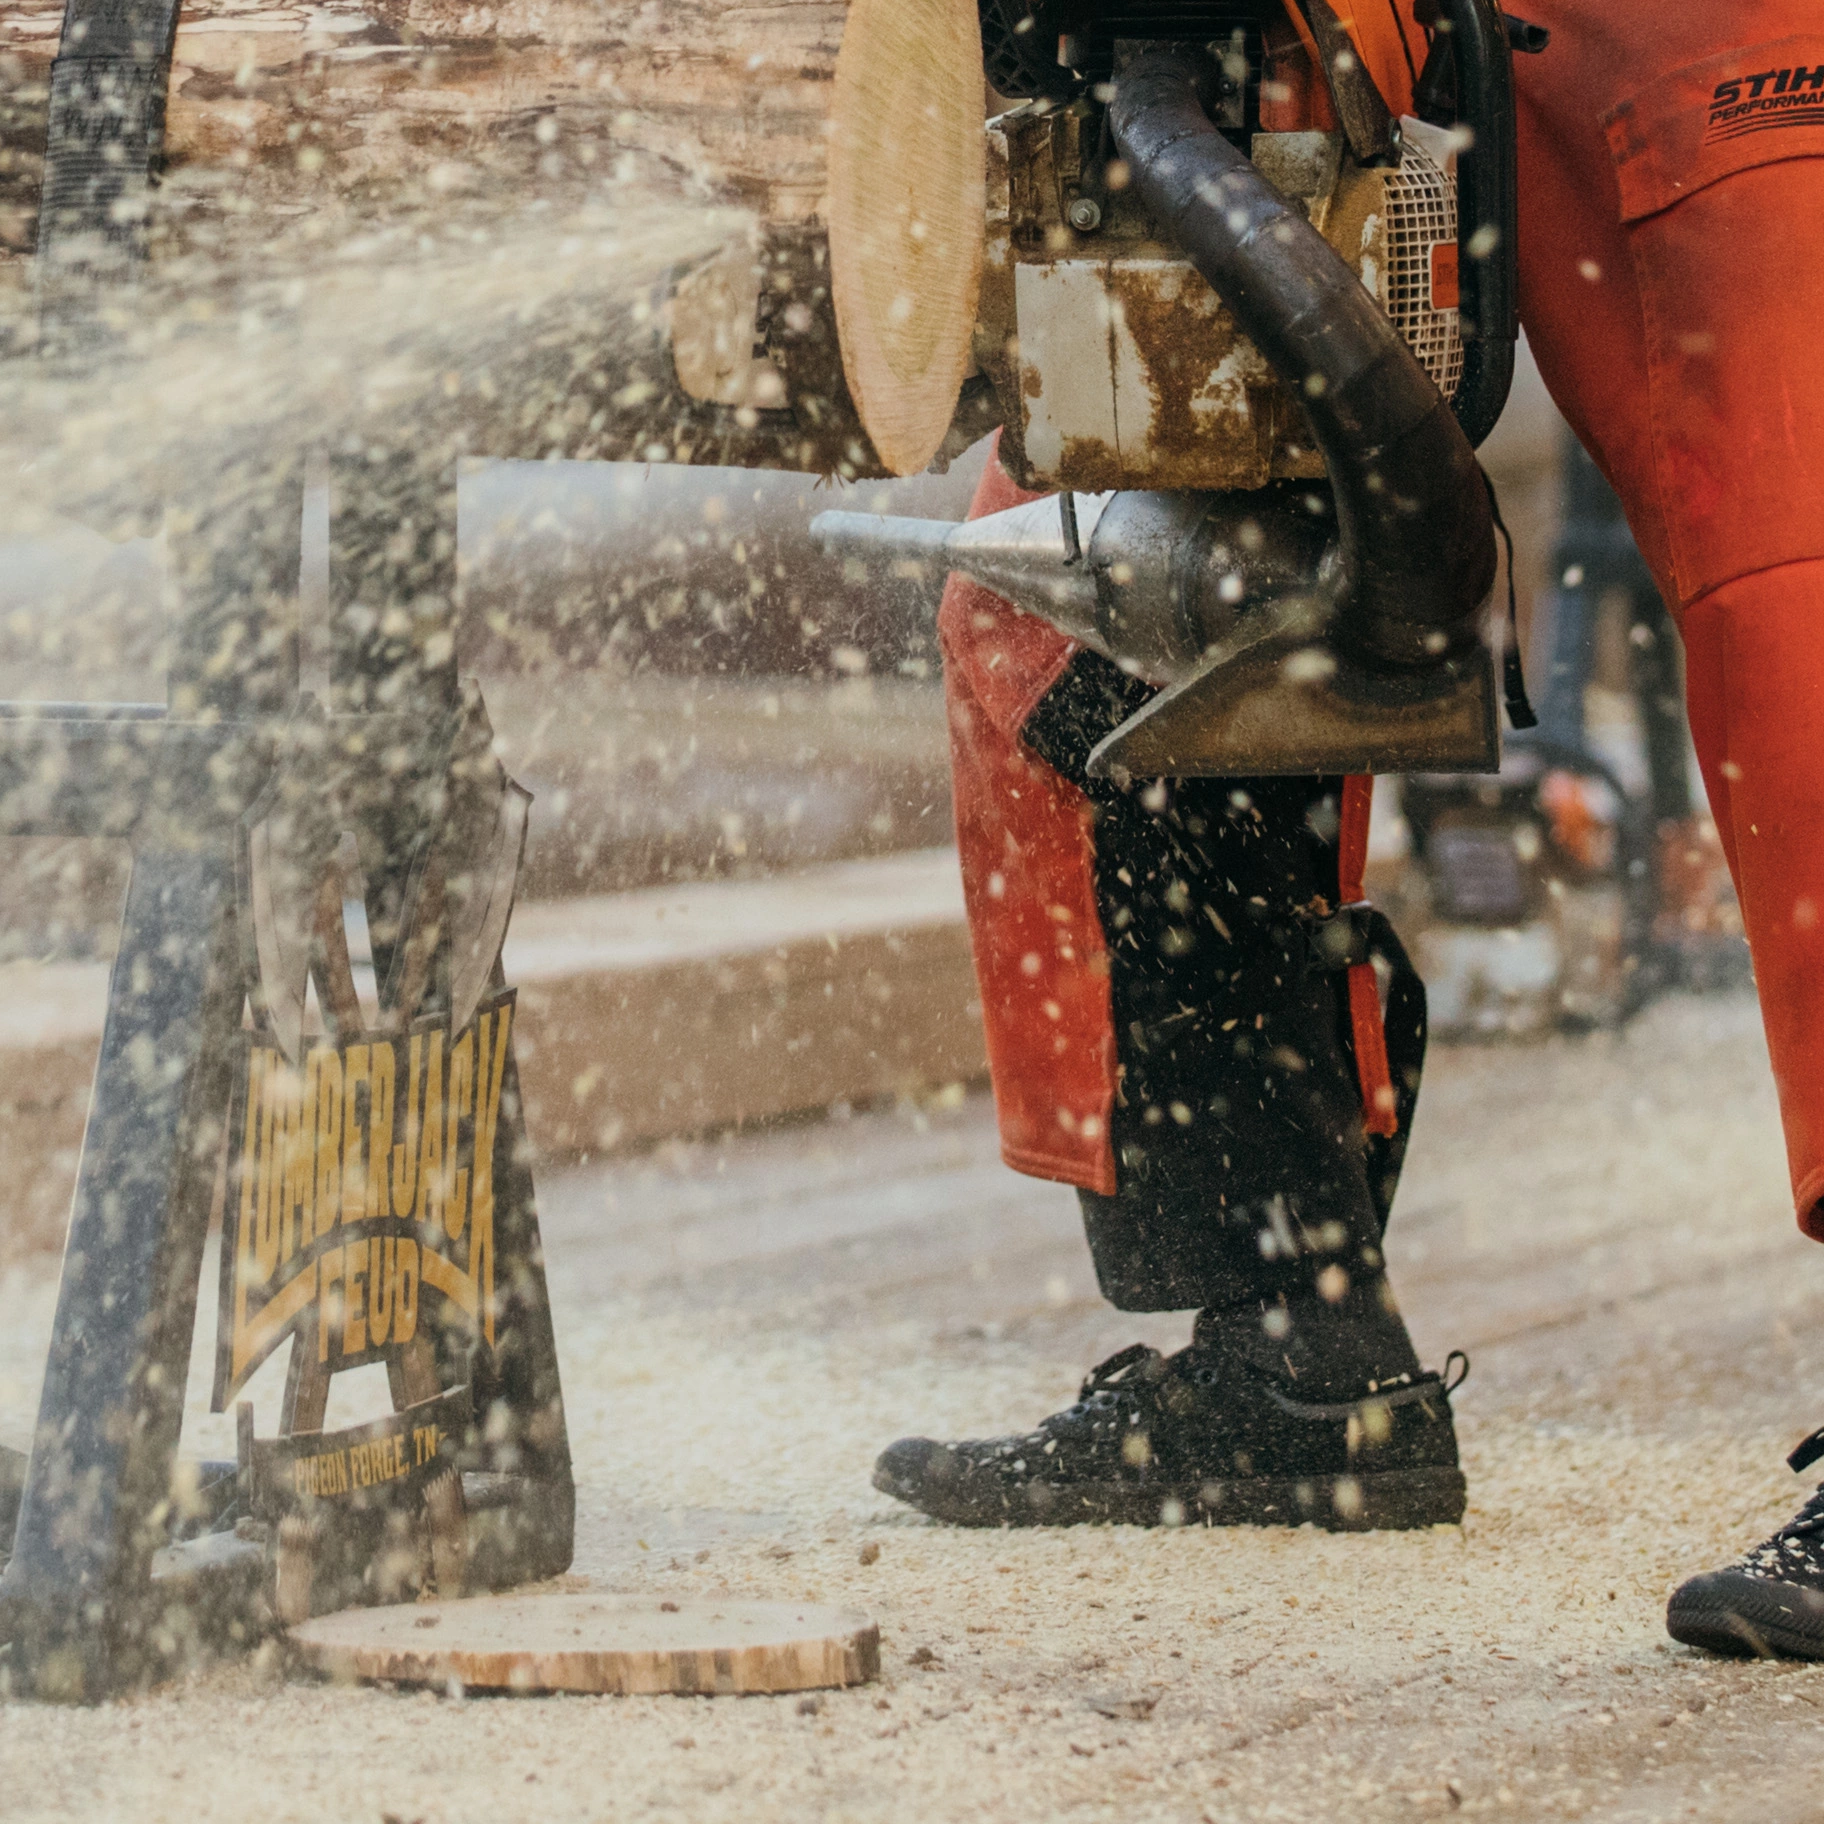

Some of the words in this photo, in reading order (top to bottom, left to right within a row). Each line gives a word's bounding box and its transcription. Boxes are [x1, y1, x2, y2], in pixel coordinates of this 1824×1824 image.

[230, 1004, 512, 1382] LUMBERJACK
[318, 1236, 420, 1363] FEUD
[295, 1449, 348, 1496] PIGEON
[413, 1423, 437, 1467] TN
